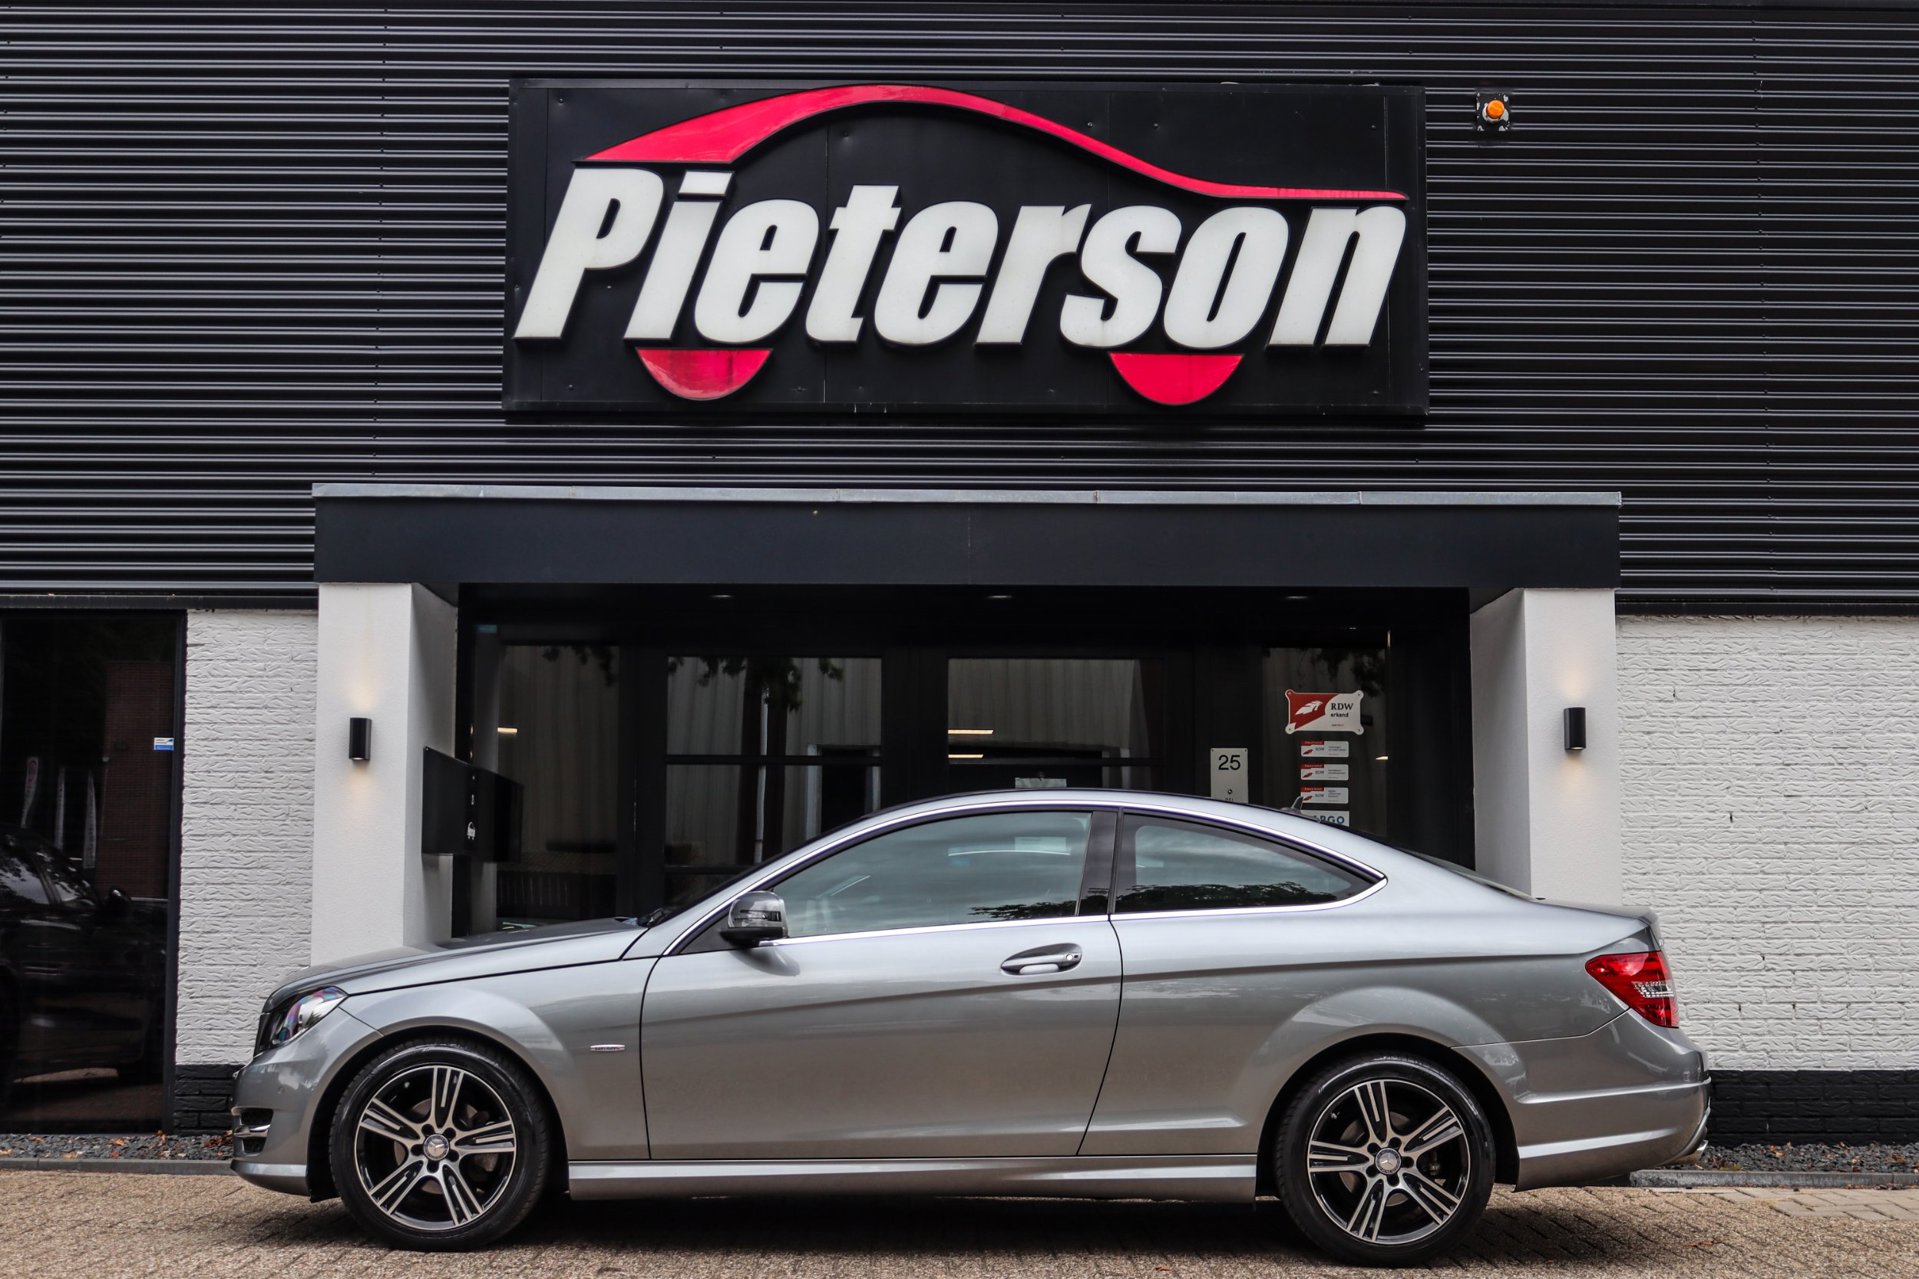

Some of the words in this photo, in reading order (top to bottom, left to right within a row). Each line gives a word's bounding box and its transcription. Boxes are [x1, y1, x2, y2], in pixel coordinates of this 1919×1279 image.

[515, 169, 1405, 347] Pieterson
[1331, 703, 1354, 711] RDW
[1218, 754, 1241, 770] 25
